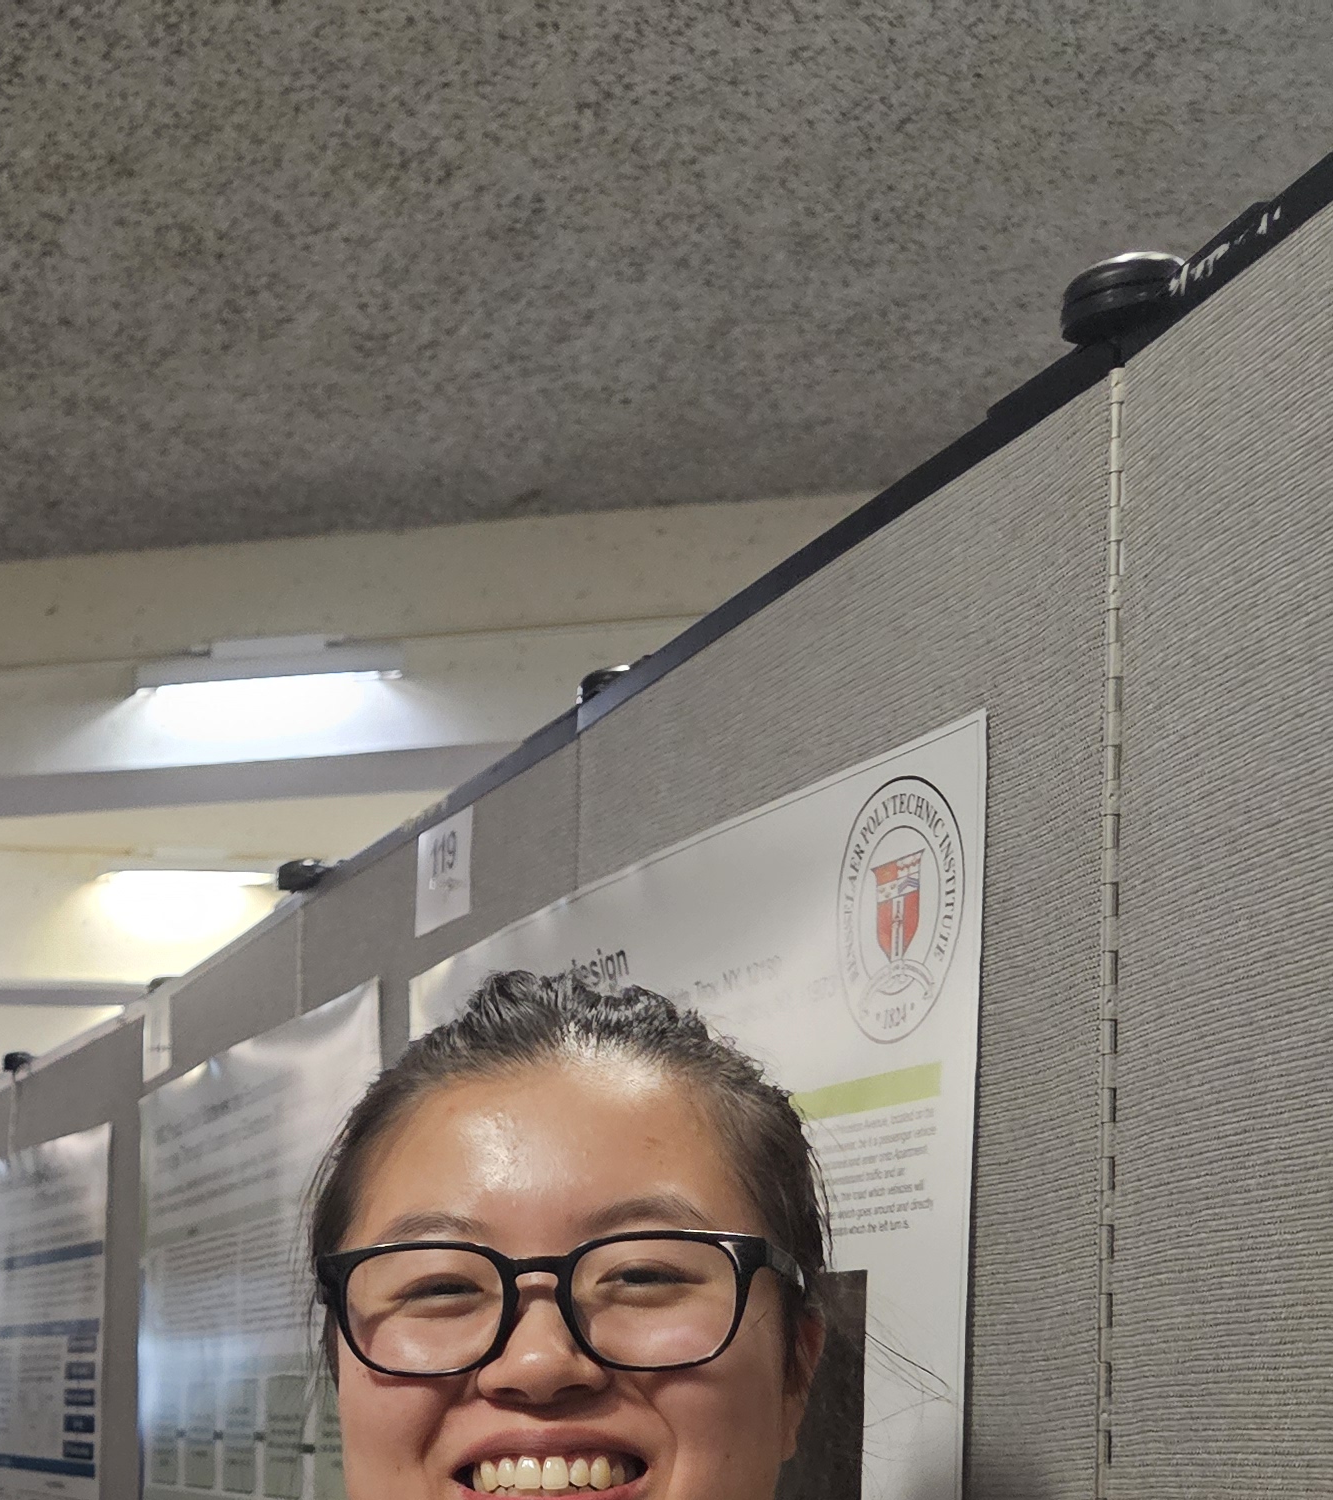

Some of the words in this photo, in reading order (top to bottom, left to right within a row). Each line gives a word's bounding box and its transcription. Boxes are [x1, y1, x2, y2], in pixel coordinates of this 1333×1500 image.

[430, 831, 459, 880] 119
[858, 792, 946, 846] POLYTECHNIC
[933, 833, 958, 963] INSTITUTE
